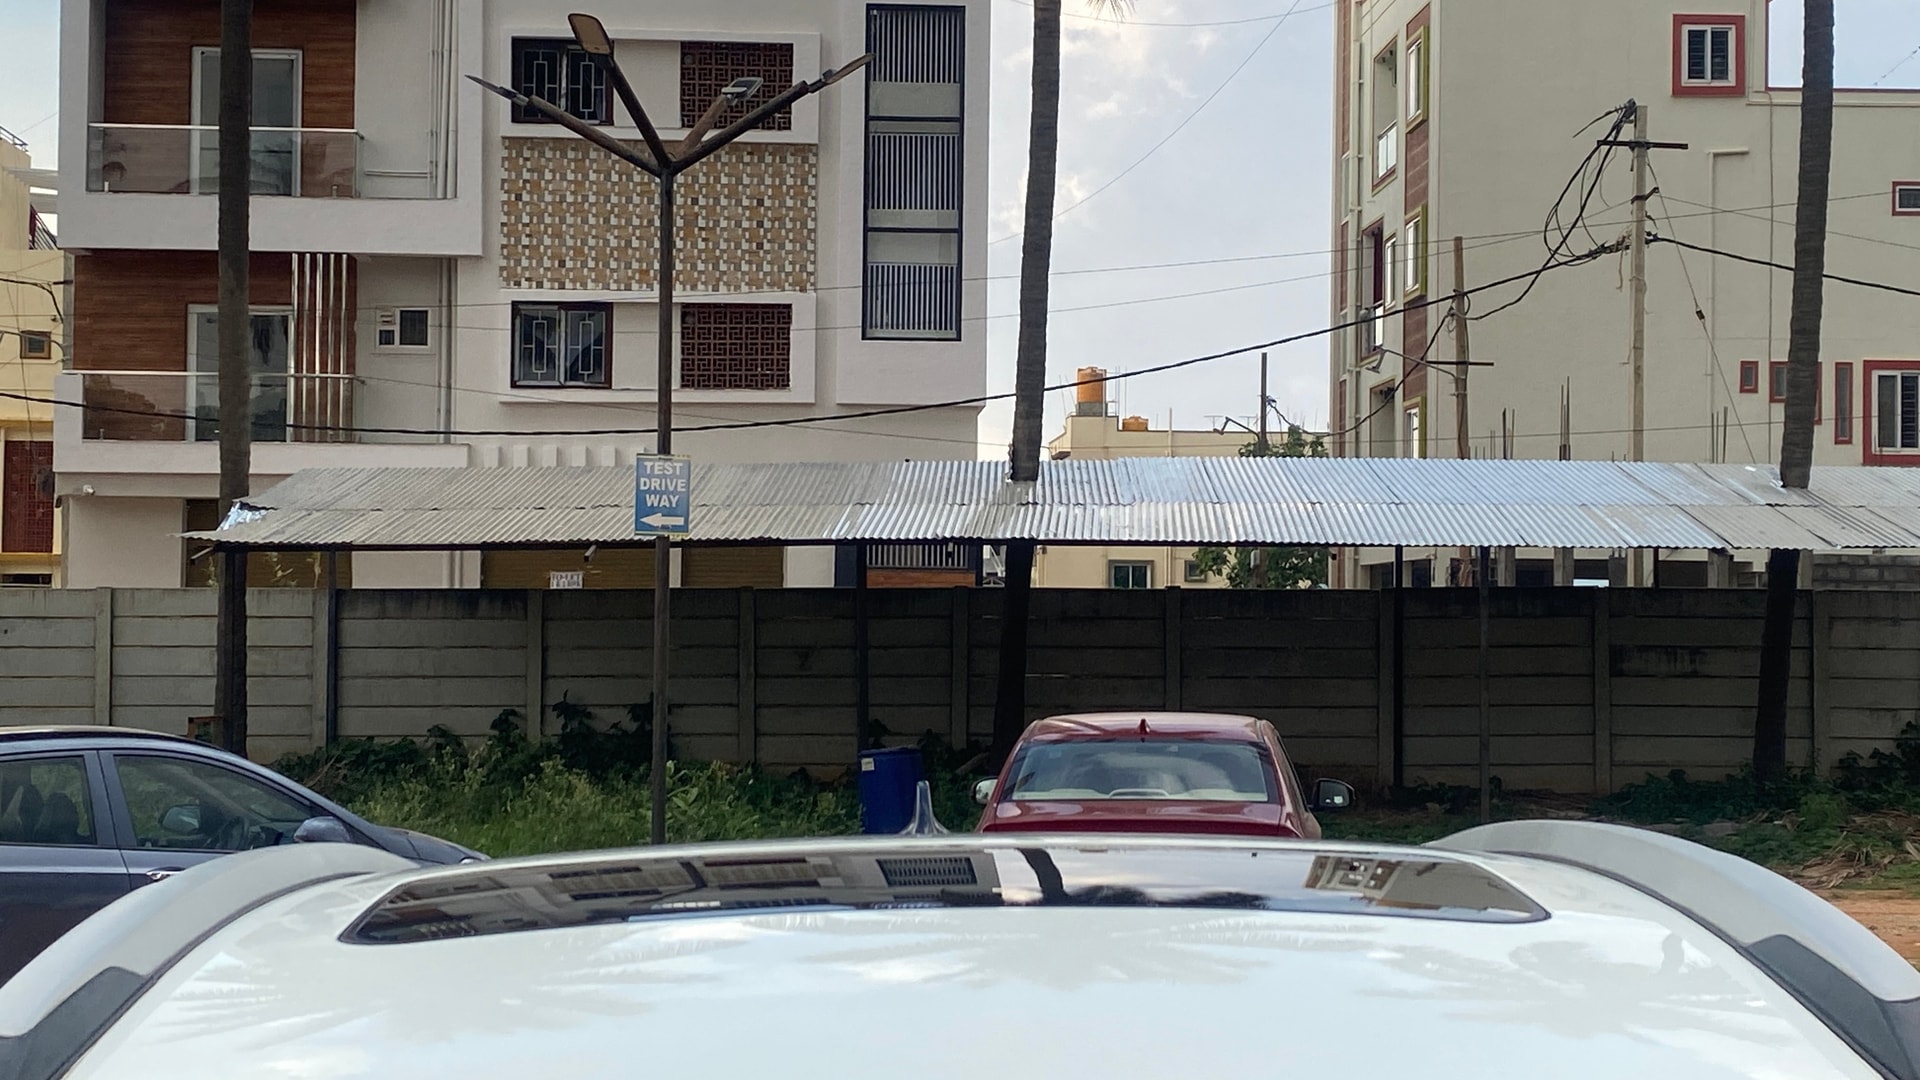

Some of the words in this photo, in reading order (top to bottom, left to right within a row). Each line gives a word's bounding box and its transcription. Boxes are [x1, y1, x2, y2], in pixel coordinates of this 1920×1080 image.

[644, 462, 683, 475] TEST
[640, 477, 686, 491] DRIVE
[646, 494, 679, 508] WAY
